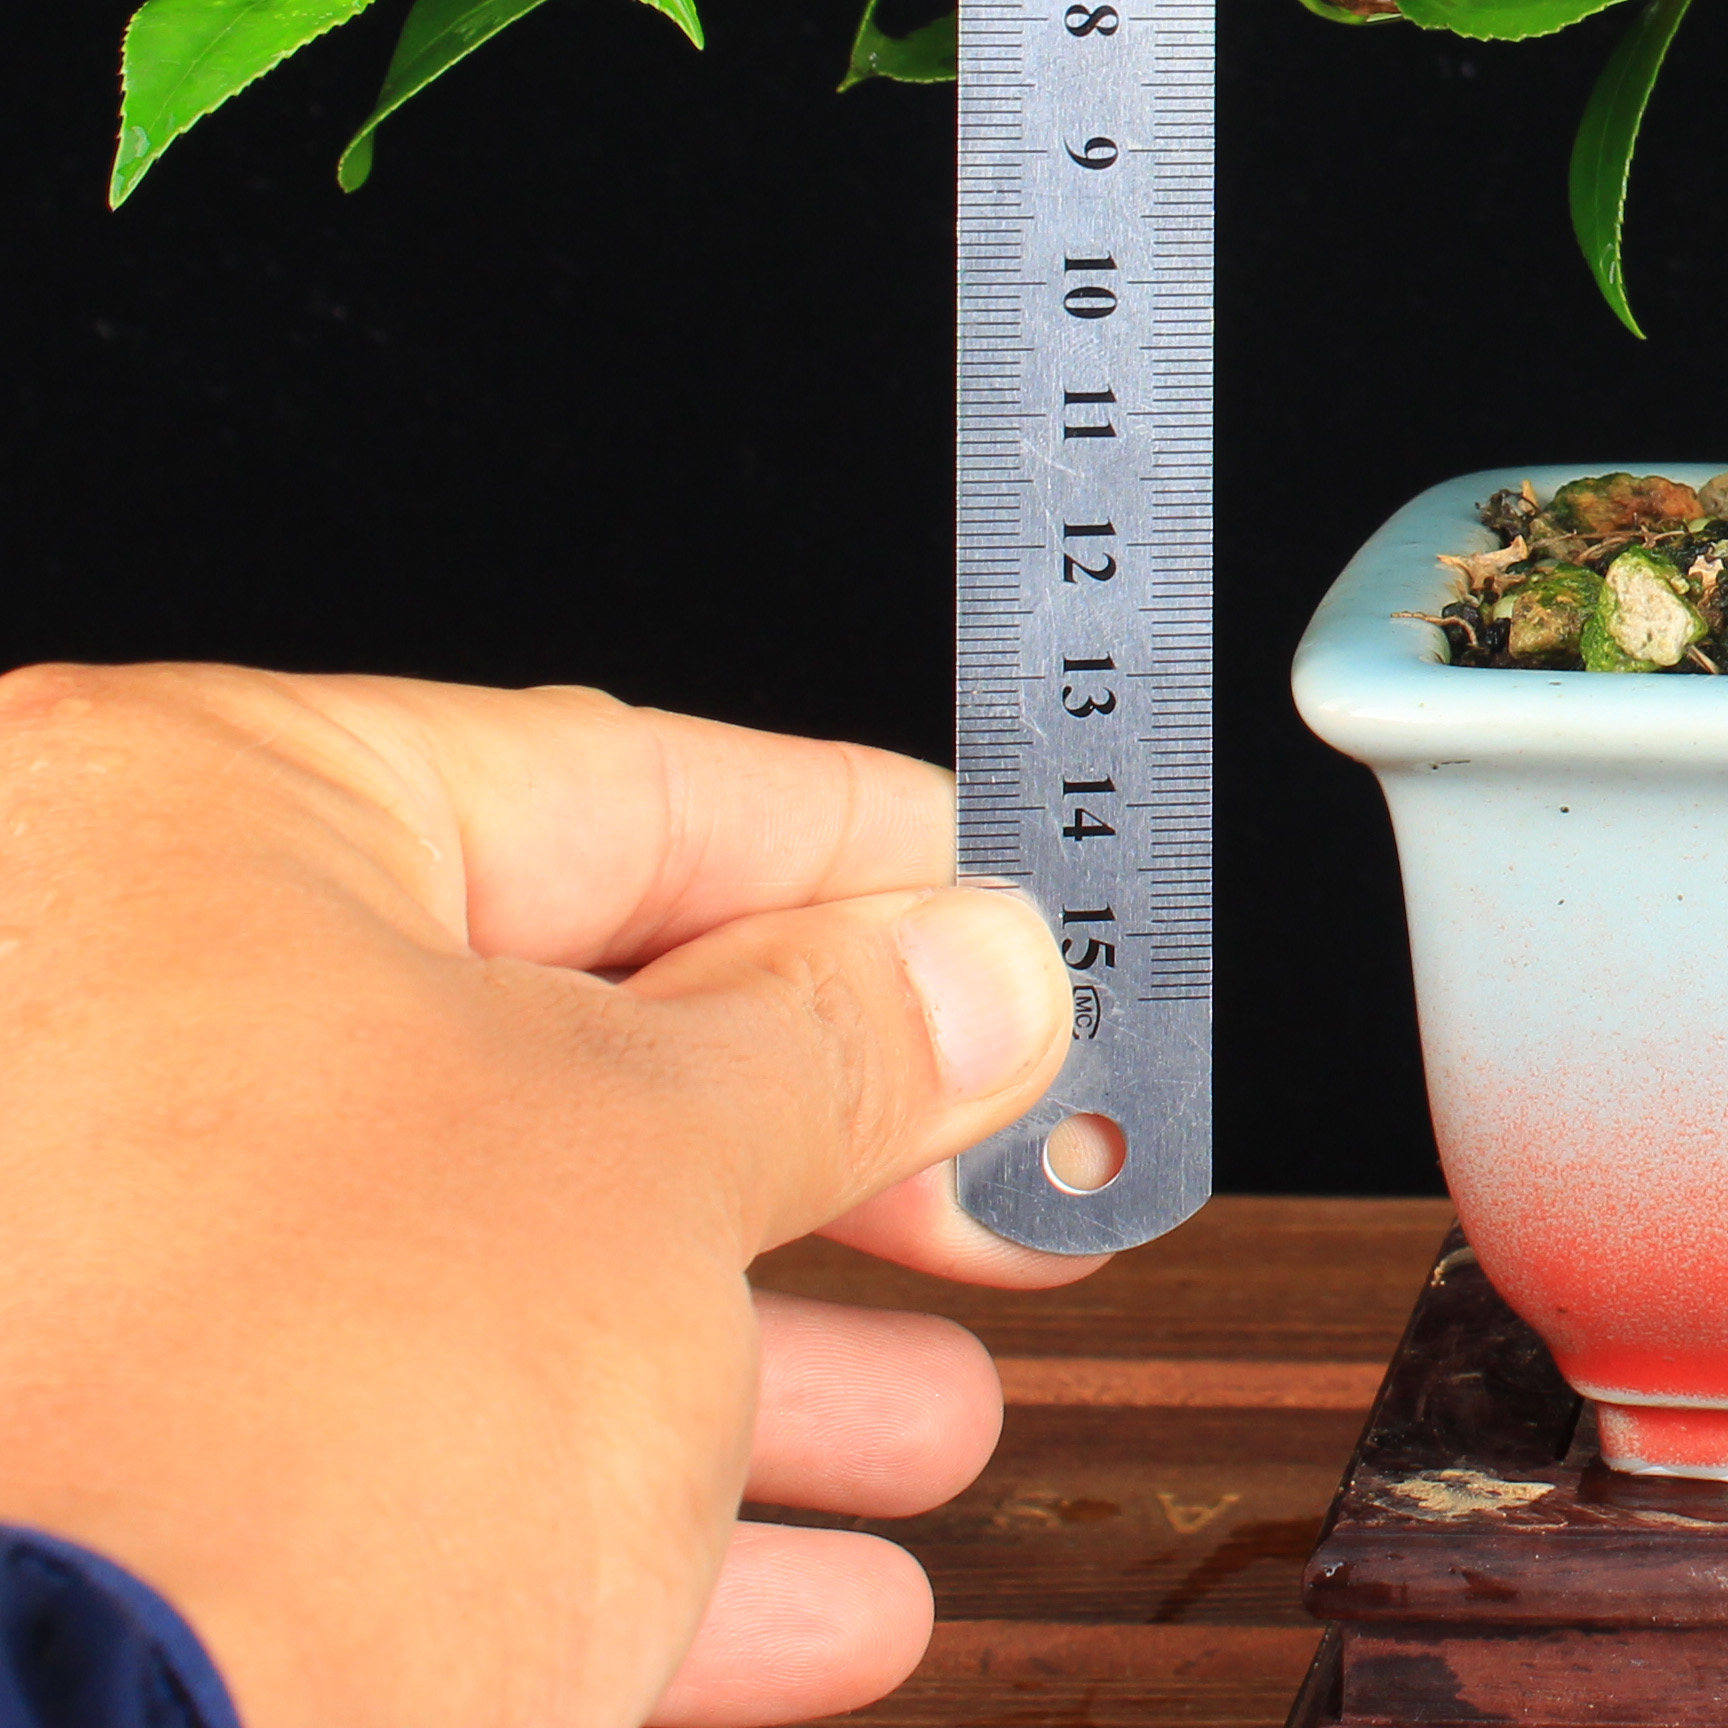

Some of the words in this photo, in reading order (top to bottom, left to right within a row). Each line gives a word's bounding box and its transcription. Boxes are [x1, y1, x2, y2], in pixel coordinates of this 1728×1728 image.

[1064, 4, 1119, 38] 8
[1064, 136, 1119, 171] 9
[1062, 251, 1118, 320] 10
[1063, 386, 1117, 442] 11
[1062, 518, 1117, 585] 12
[1061, 653, 1117, 719] 13
[1062, 775, 1117, 842] 14
[1060, 901, 1117, 971] 15
